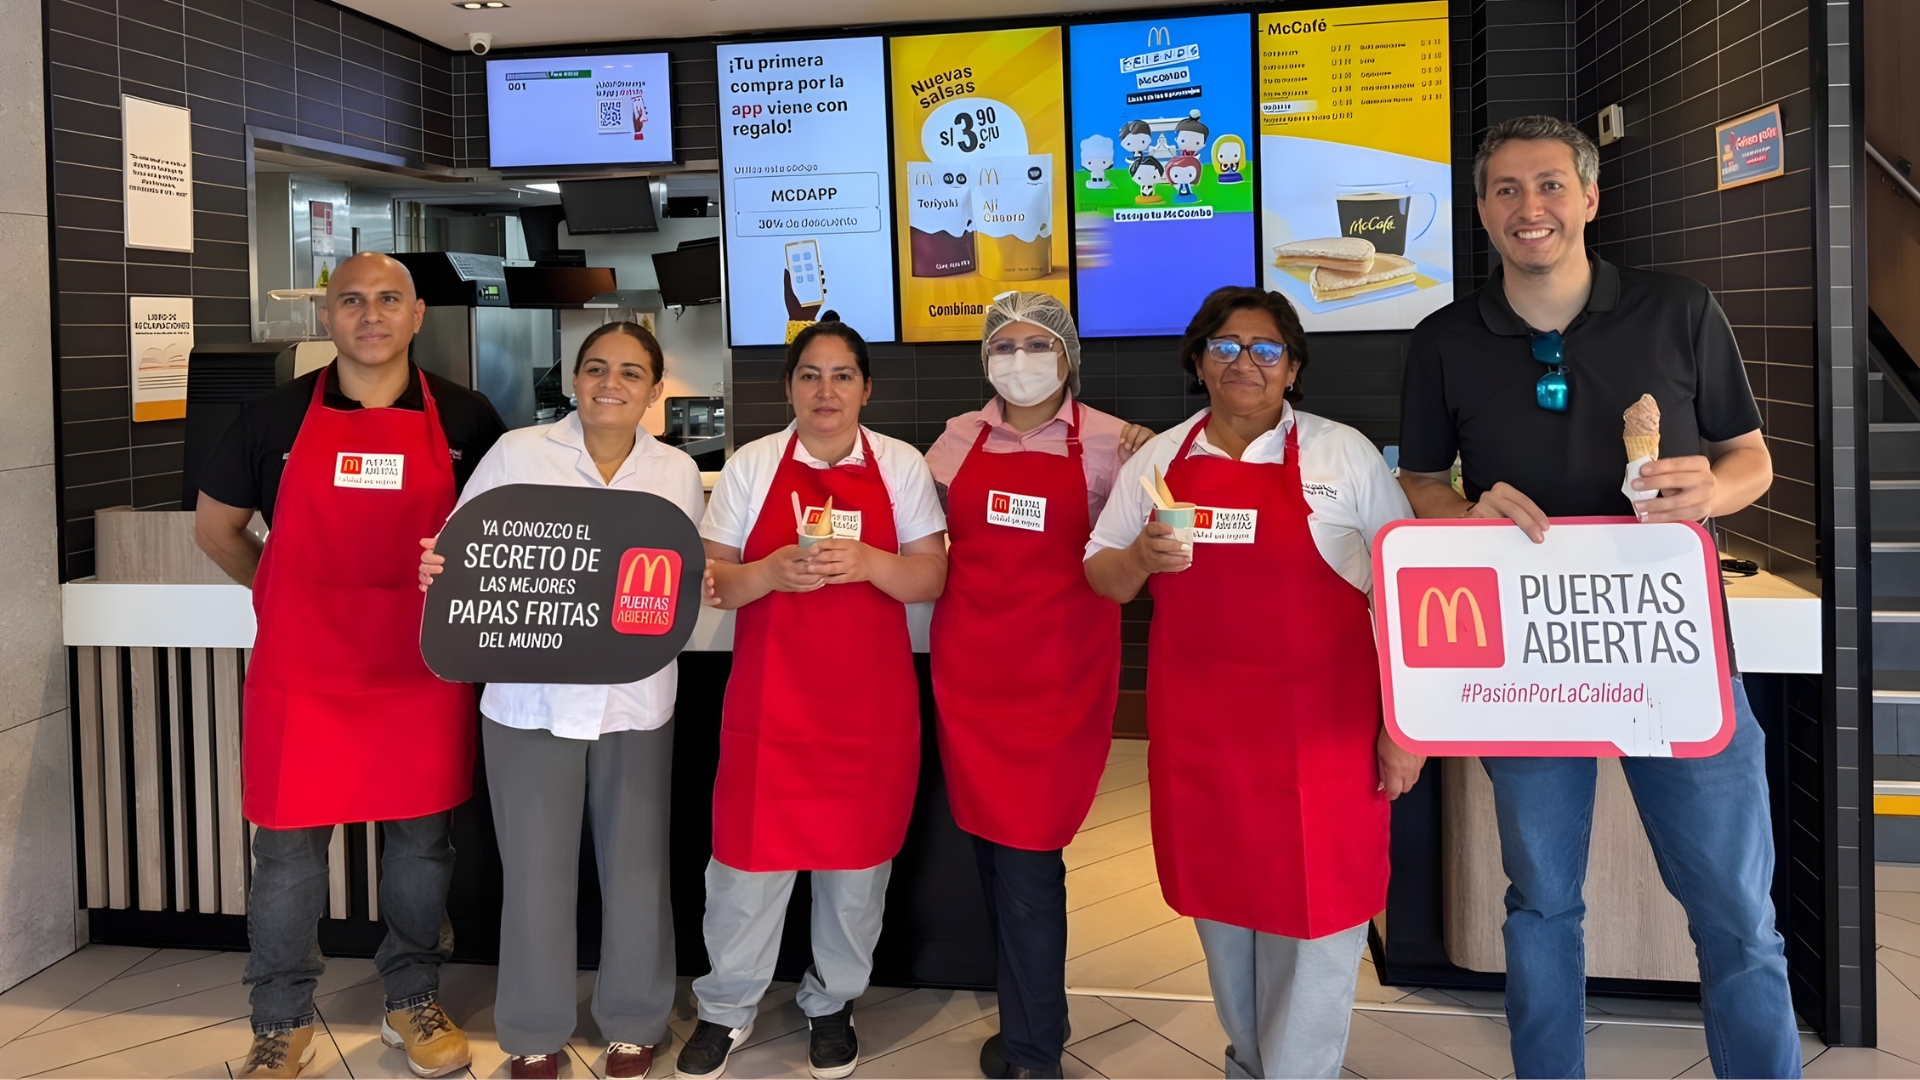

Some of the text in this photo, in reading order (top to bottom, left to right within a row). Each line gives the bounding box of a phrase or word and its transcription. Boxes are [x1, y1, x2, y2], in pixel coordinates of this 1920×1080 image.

[1267, 18, 1327, 36] McCafé
[729, 54, 824, 74] ¡Tu primera
[731, 74, 844, 95] compra por la
[911, 67, 973, 97] Nuevas
[919, 81, 976, 109] salsas
[731, 100, 848, 119] app viene con
[733, 119, 792, 139] regalo!
[771, 187, 838, 203] MCDAPP
[482, 519, 592, 540] YA CONOZCO EL
[464, 542, 601, 573] SECRETO DE
[479, 576, 576, 595] LAS MEJORES
[1519, 572, 1686, 615] PUERTAS
[619, 595, 669, 611] PUERTAS
[448, 599, 601, 628] PAPAS FRITAS
[616, 609, 669, 625] ABIERTAS
[478, 631, 563, 649] DEL MUNDO
[1522, 619, 1701, 664] ABIERTAS
[1460, 683, 1645, 704] #PasiónPorLaCalidad
